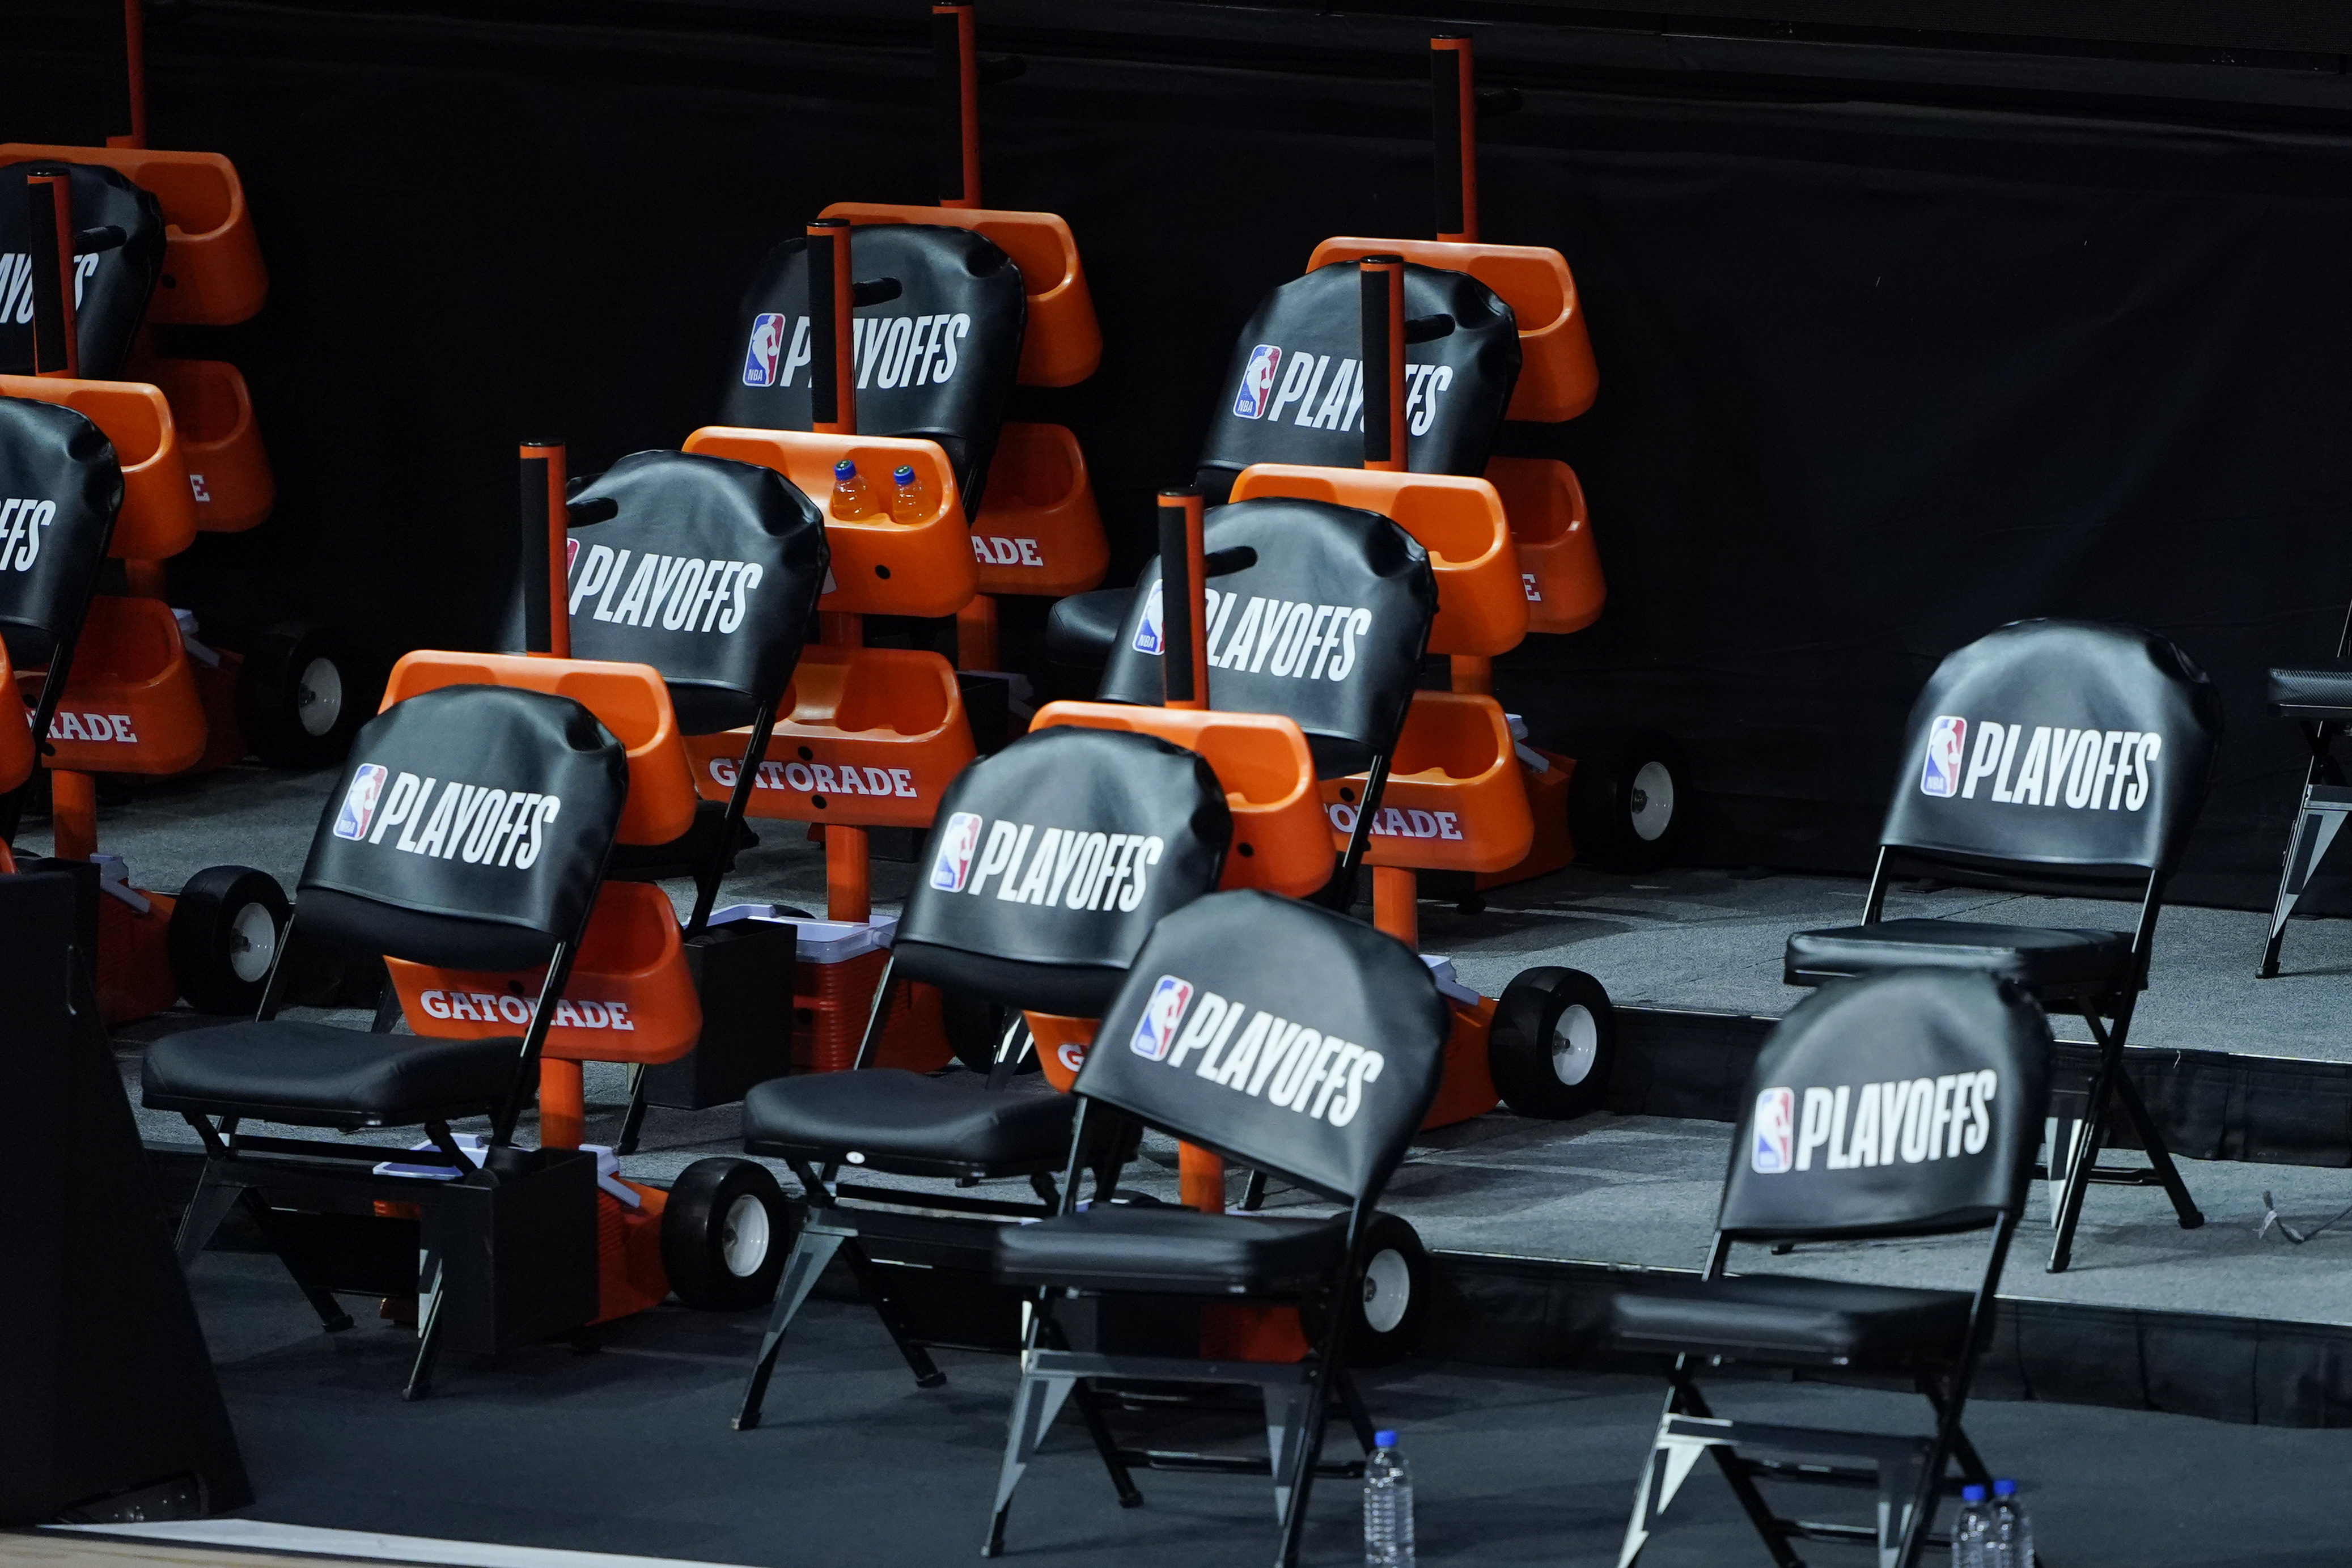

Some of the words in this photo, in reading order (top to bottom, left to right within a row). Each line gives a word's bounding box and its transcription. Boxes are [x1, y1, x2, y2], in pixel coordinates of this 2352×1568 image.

[747, 368, 763, 381] NBA
[1238, 400, 1253, 413] NBA
[1268, 351, 1453, 437] PLAYFS
[0, 498, 56, 571] FFS
[569, 544, 763, 634] PLAYOFFS
[1138, 634, 1155, 649] NBA
[1962, 722, 2162, 811] PLAYOFFS
[369, 772, 560, 869] PLAYOFFS
[968, 820, 1164, 912] PLAYOFFS
[1168, 991, 1384, 1126] PLAYOFFS
[1795, 1070, 1997, 1171] PLAYOFFS
